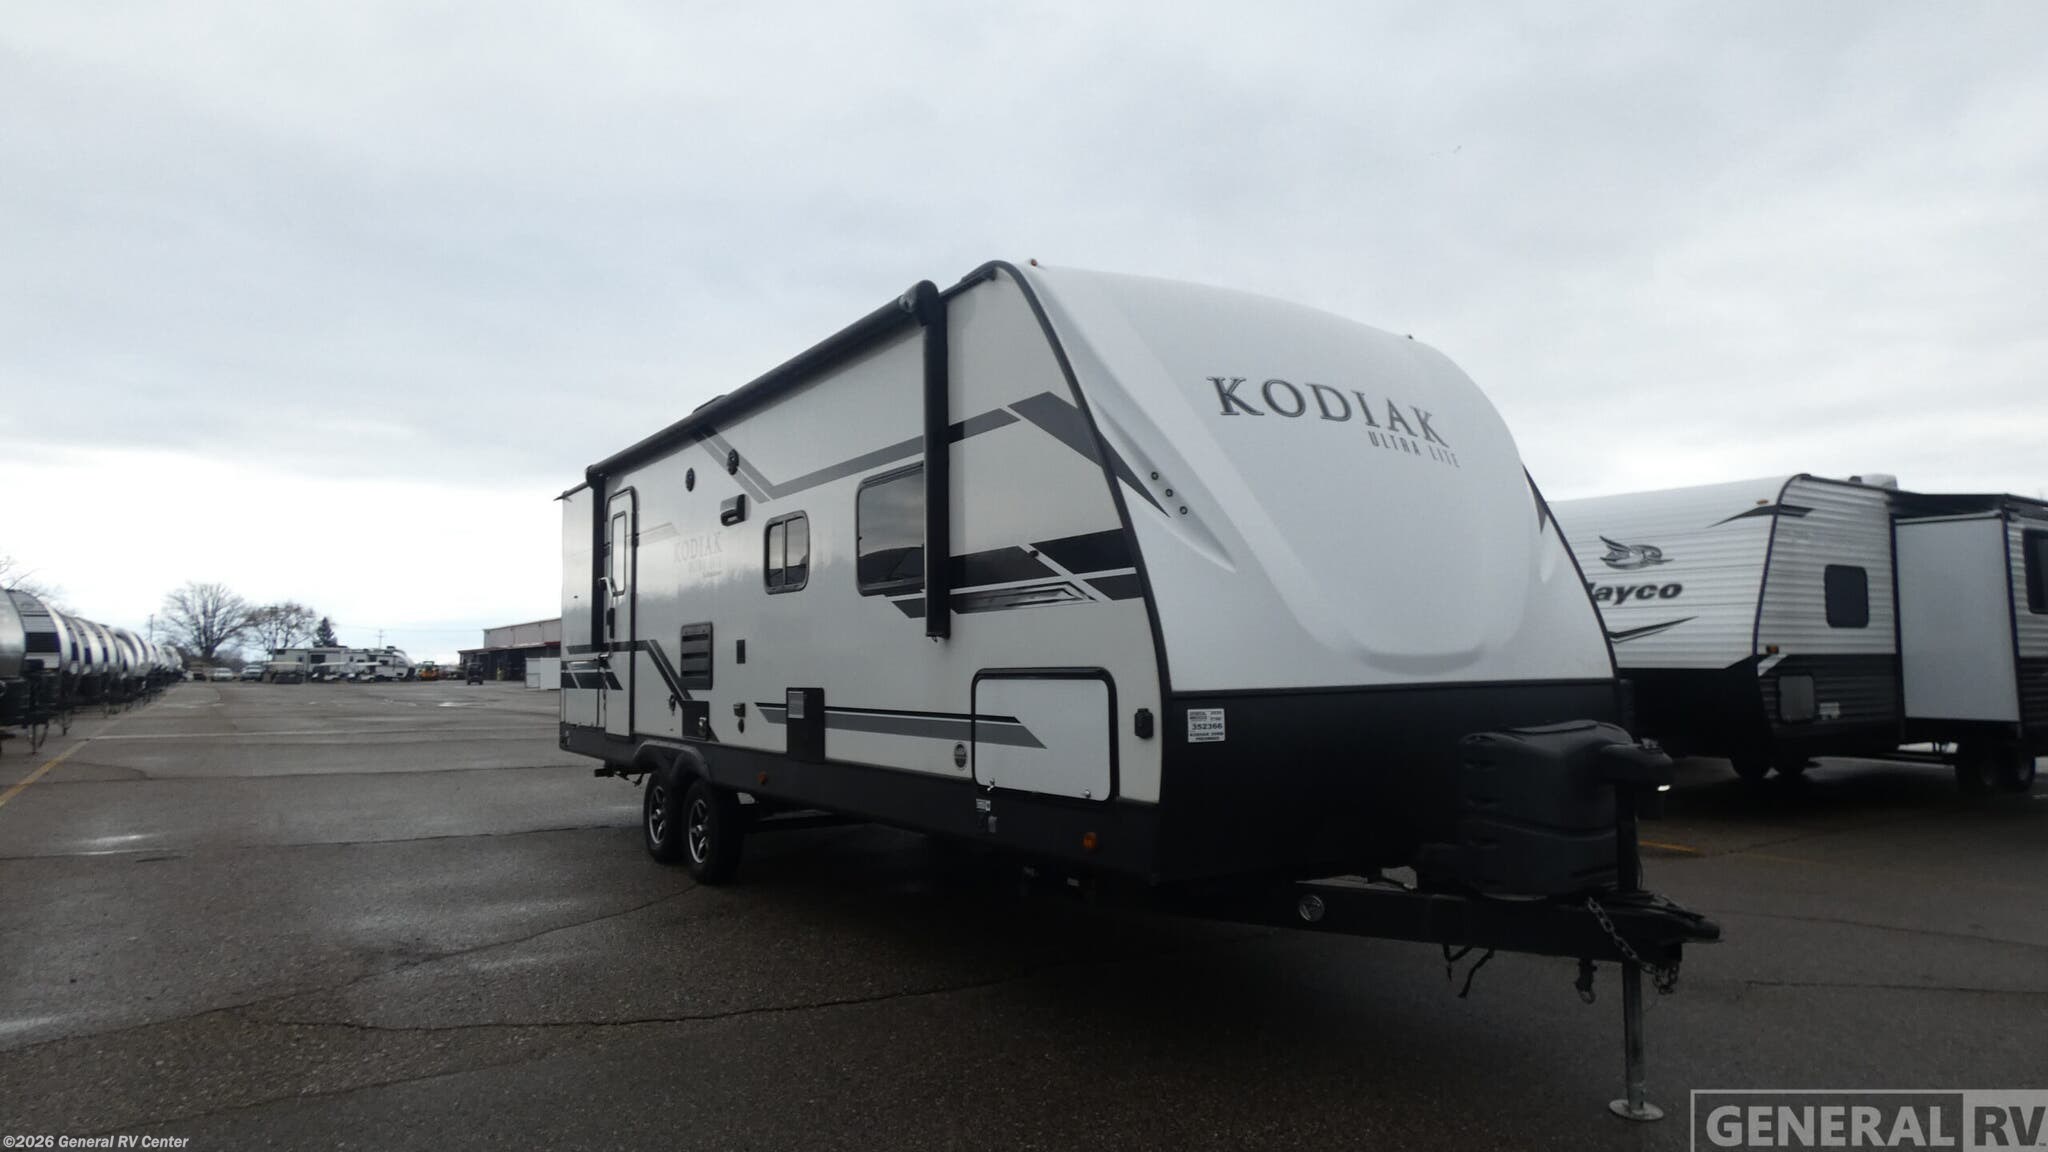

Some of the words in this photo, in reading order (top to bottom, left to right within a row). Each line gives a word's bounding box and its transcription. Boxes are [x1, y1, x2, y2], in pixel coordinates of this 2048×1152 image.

[1206, 376, 1449, 449] KODIAK
[1367, 430, 1421, 456] ULTRA
[1428, 445, 1460, 468] LITE
